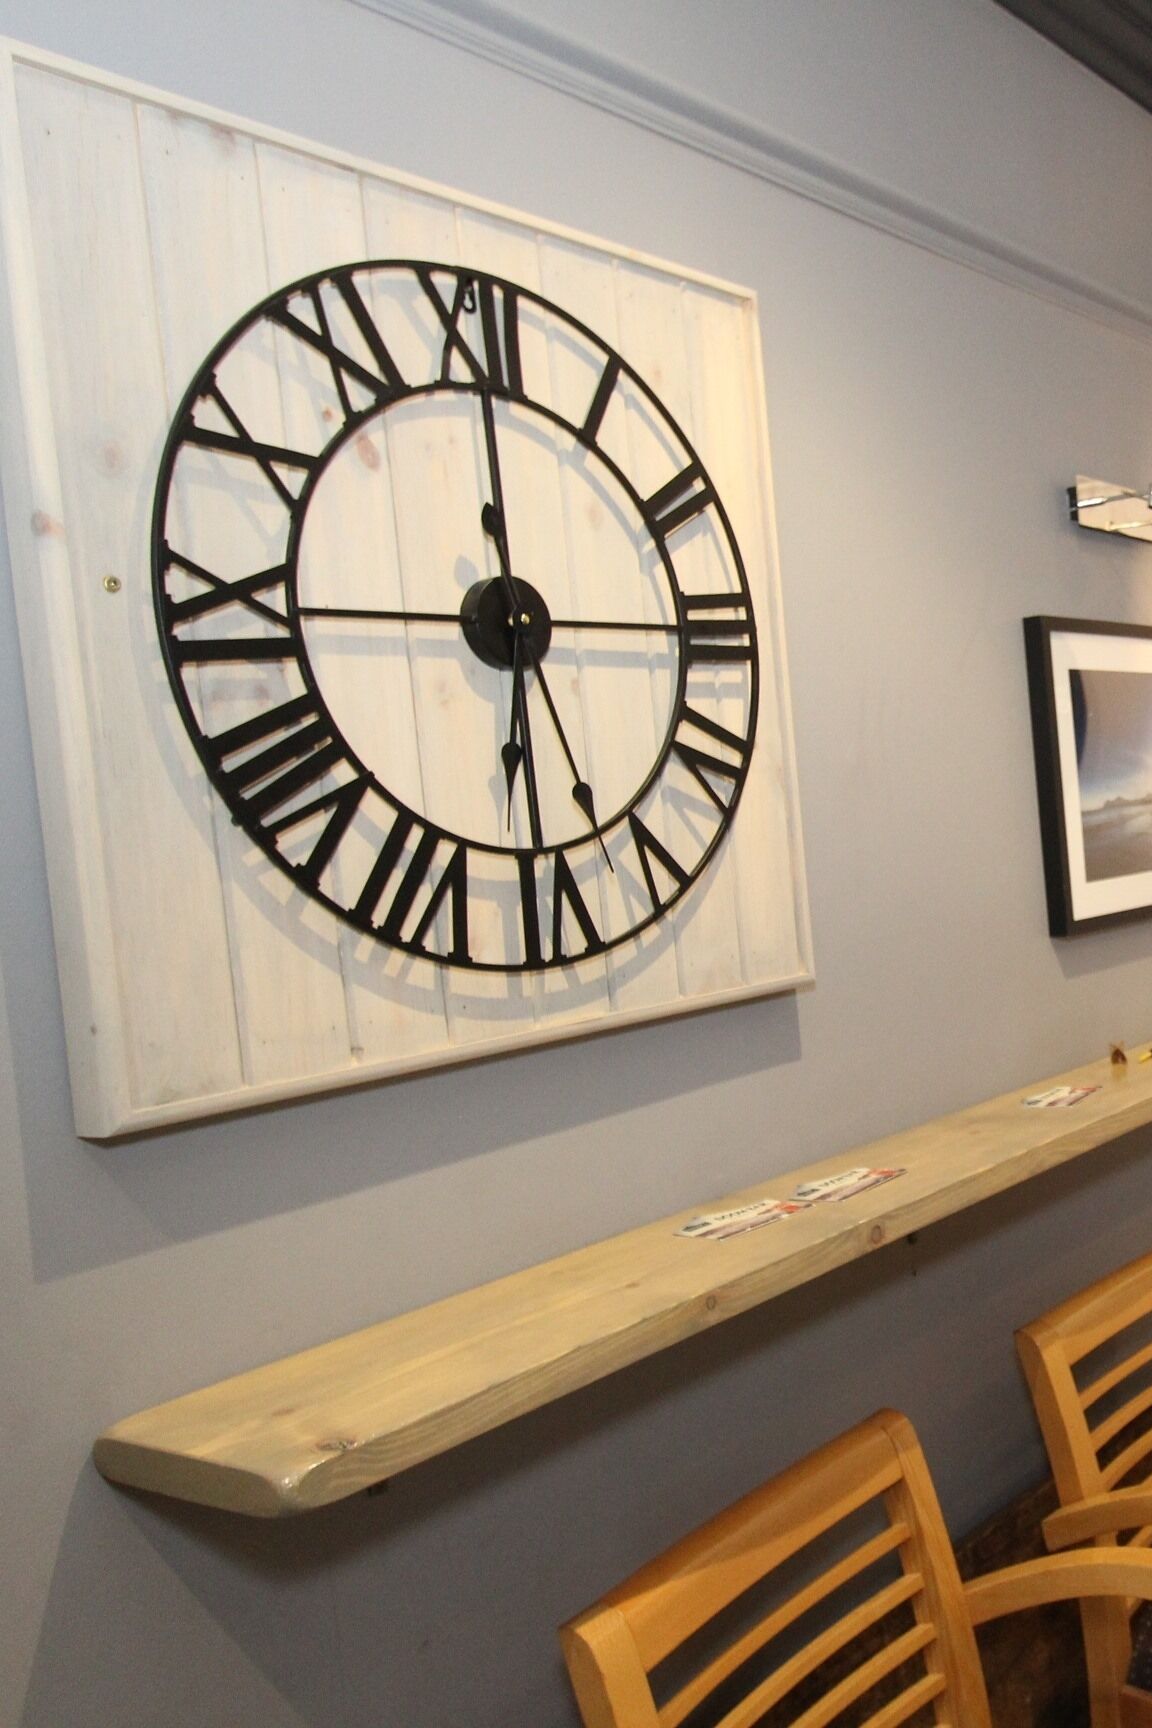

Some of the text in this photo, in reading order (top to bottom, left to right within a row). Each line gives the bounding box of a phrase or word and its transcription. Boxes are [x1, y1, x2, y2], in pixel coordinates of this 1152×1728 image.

[264, 269, 411, 424] XI
[413, 266, 527, 400] XII
[179, 372, 322, 519] X
[578, 354, 622, 447] I
[642, 461, 717, 540] II
[161, 540, 298, 659] IX
[679, 592, 759, 660] III
[201, 689, 374, 887] VIII
[673, 701, 752, 820] IV
[349, 806, 470, 963] VII
[516, 848, 606, 966] VI
[627, 811, 691, 912] V
